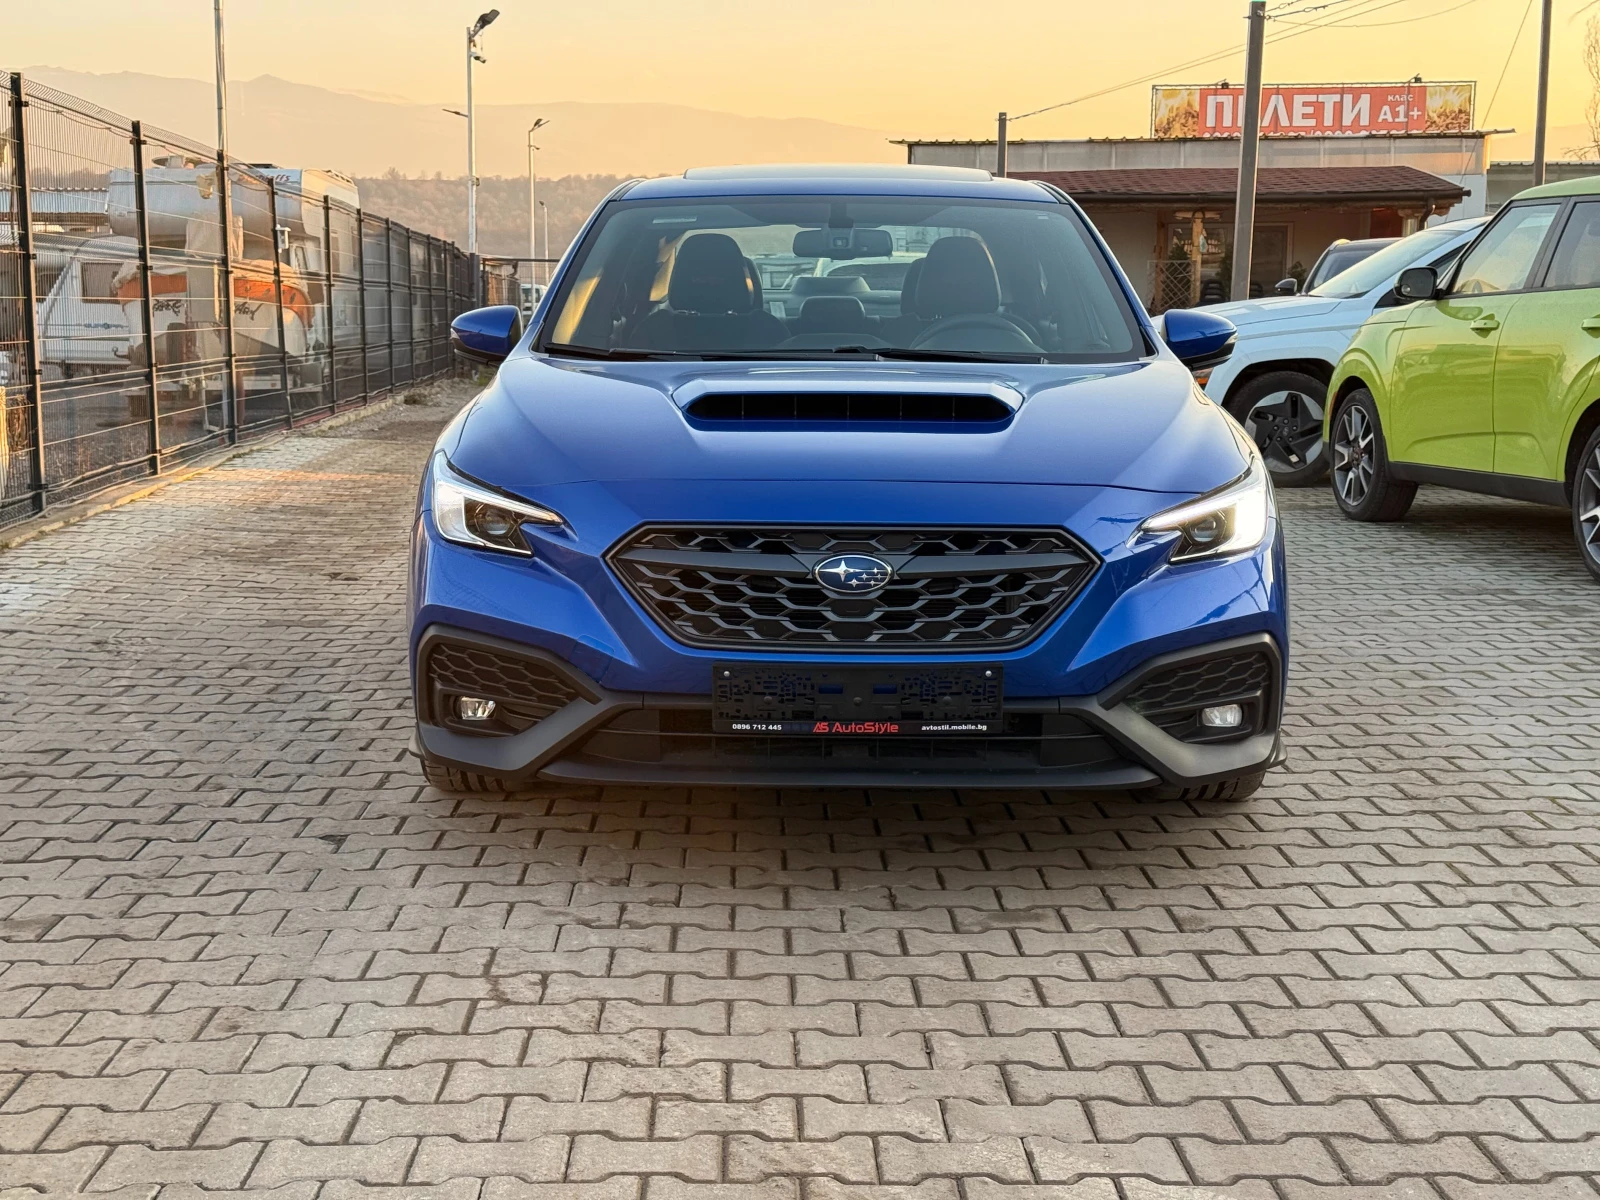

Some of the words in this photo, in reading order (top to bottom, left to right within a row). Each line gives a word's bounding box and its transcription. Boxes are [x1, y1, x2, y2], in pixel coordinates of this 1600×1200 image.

[1206, 93, 1371, 127] ПЛЕТИ
[812, 721, 829, 733] AS
[832, 721, 899, 734] AutoStyle
[921, 723, 987, 731] avtostil.mobile.bg
